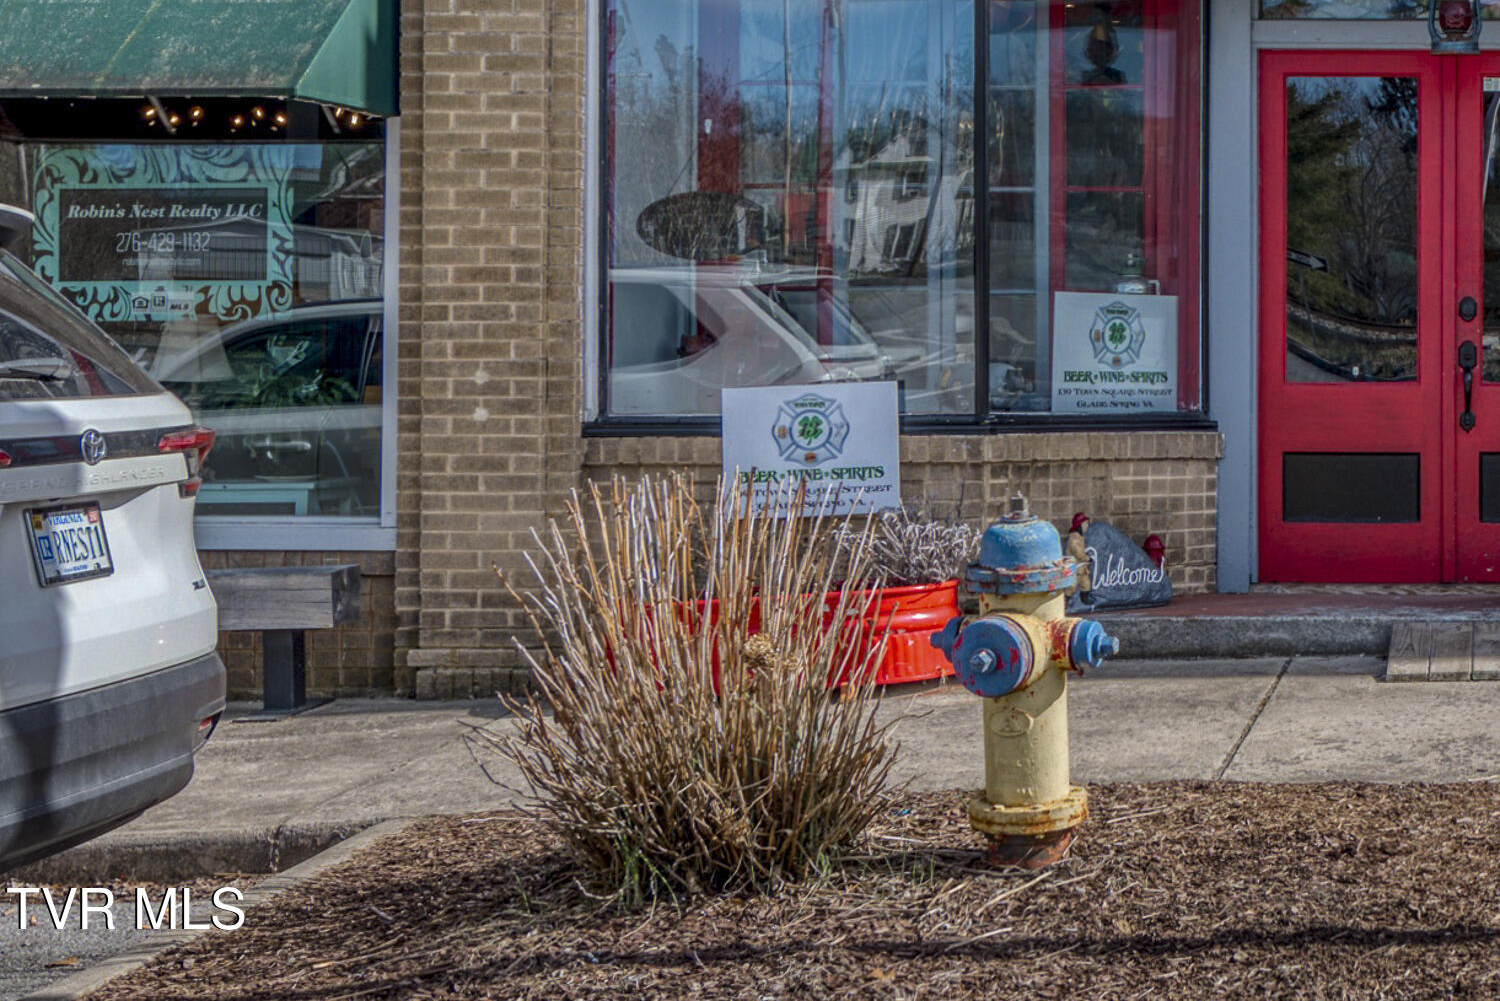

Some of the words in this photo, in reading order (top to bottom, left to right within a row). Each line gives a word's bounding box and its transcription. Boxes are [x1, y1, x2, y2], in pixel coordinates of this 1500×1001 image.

[67, 203, 125, 219] Robin's
[129, 203, 165, 218] Nest
[169, 203, 221, 220] Realty
[224, 203, 263, 218] LLC
[116, 232, 211, 252] 276-429-1132
[1064, 371, 1095, 385] BEER
[1099, 371, 1125, 383] WINE
[1130, 371, 1168, 385] SPIRITS
[787, 468, 823, 481] WINE
[830, 466, 885, 481] SPIRITS
[52, 525, 105, 564] RNEST1
[1085, 546, 1165, 590] Welcome
